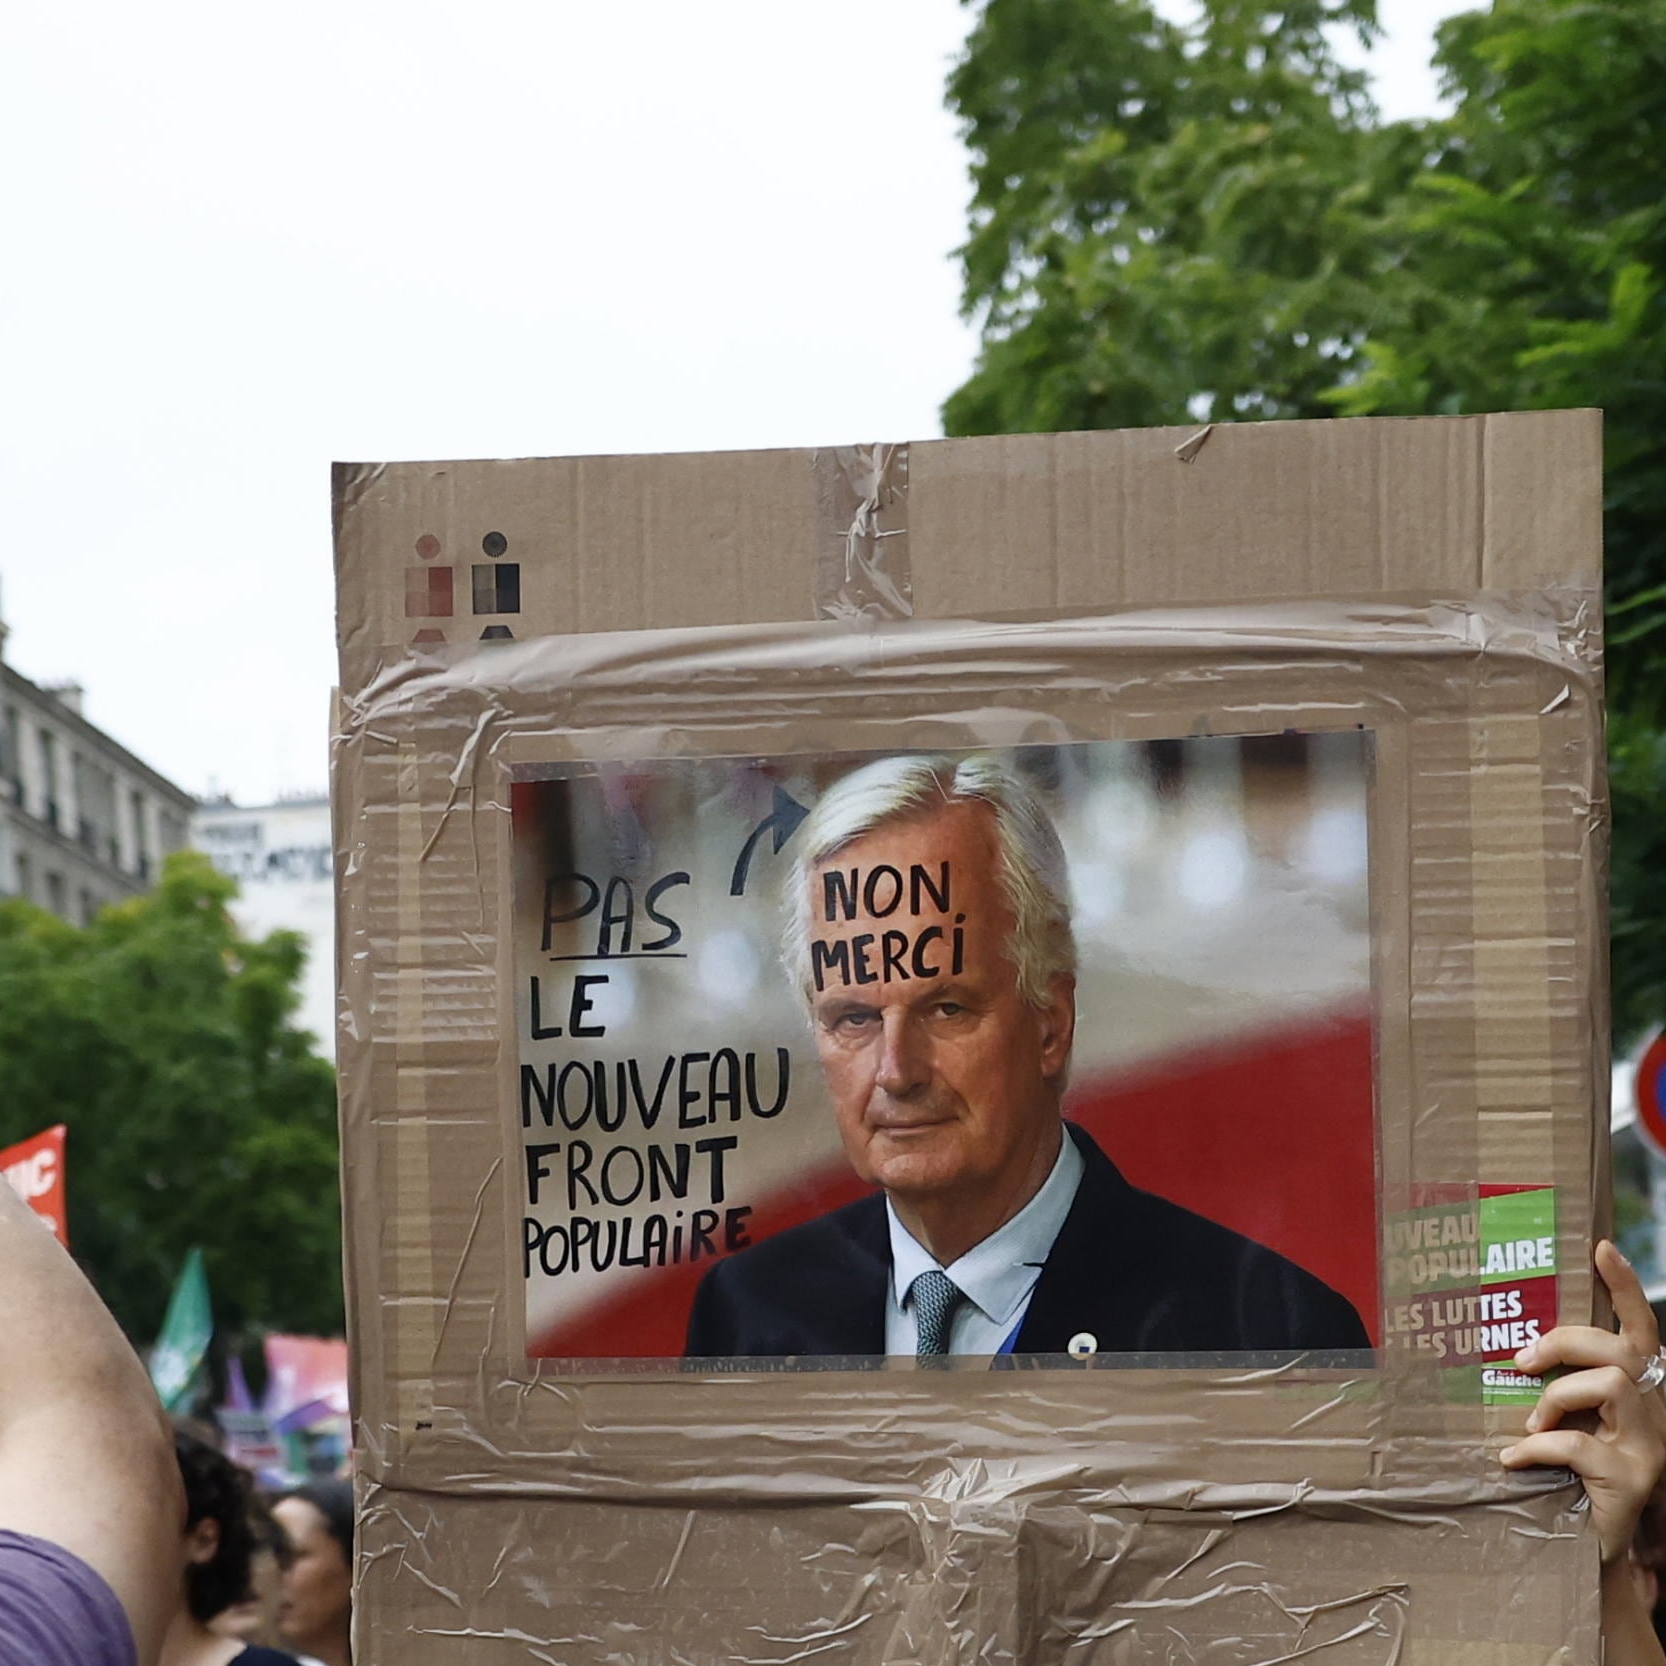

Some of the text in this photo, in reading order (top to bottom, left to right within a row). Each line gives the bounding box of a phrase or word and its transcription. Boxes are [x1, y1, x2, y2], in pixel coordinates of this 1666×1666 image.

[541, 871, 690, 957] PAS
[823, 860, 950, 922] NON
[530, 975, 609, 1040] LE
[520, 1047, 790, 1132] NOUVEAU
[525, 1135, 738, 1210] FRONT
[1388, 1237, 1554, 1285] POPULAIRE
[1432, 1290, 1523, 1328] LUTTES
[1454, 1319, 1541, 1355] URNES
[1482, 1369, 1542, 1387] Gauche
